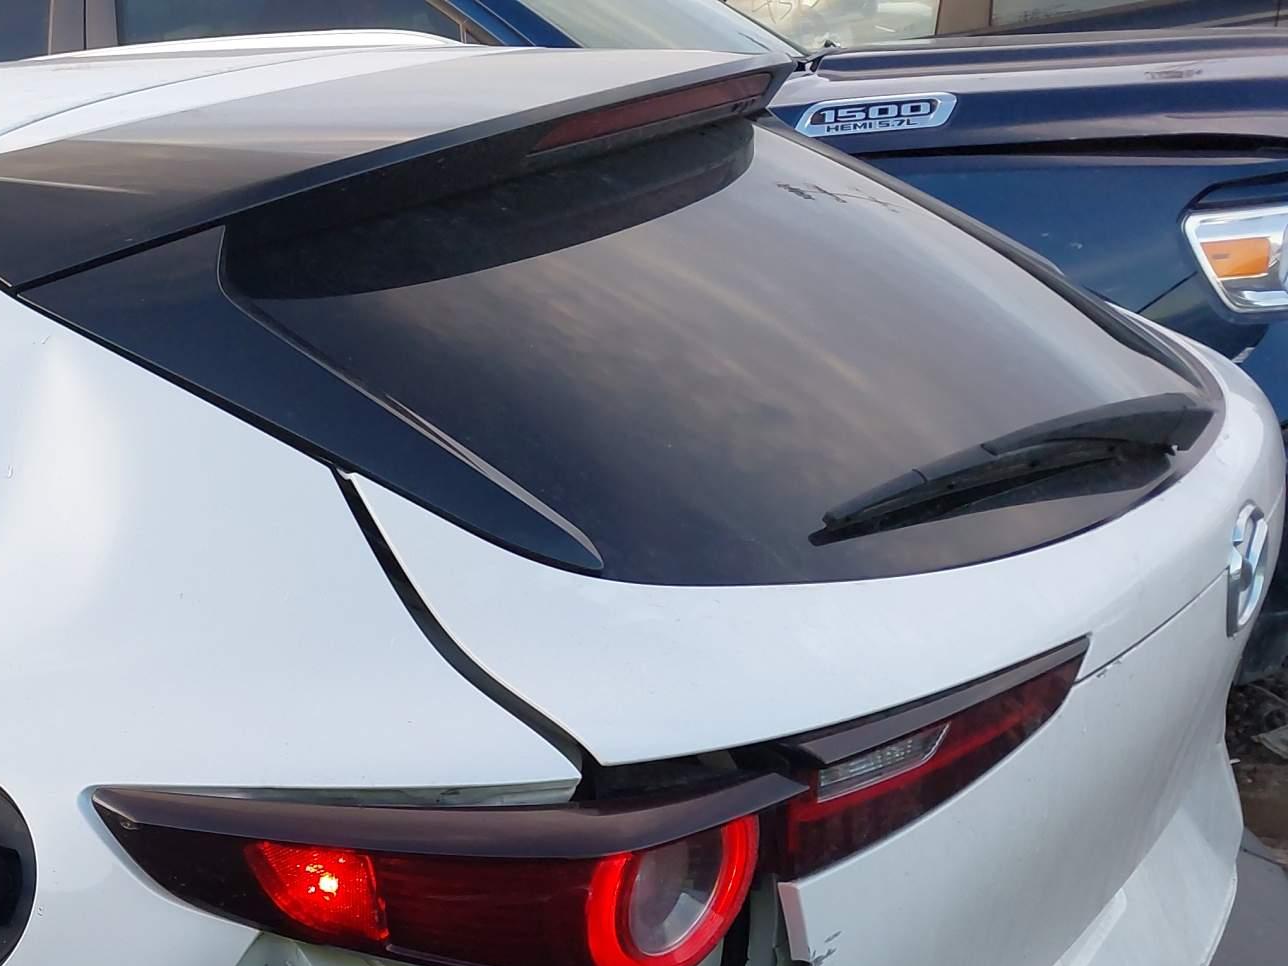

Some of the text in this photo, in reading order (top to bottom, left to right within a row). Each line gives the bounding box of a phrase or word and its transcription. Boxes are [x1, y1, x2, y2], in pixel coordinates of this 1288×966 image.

[820, 101, 931, 124] 1500
[825, 118, 918, 133] HEMI 5.7L
